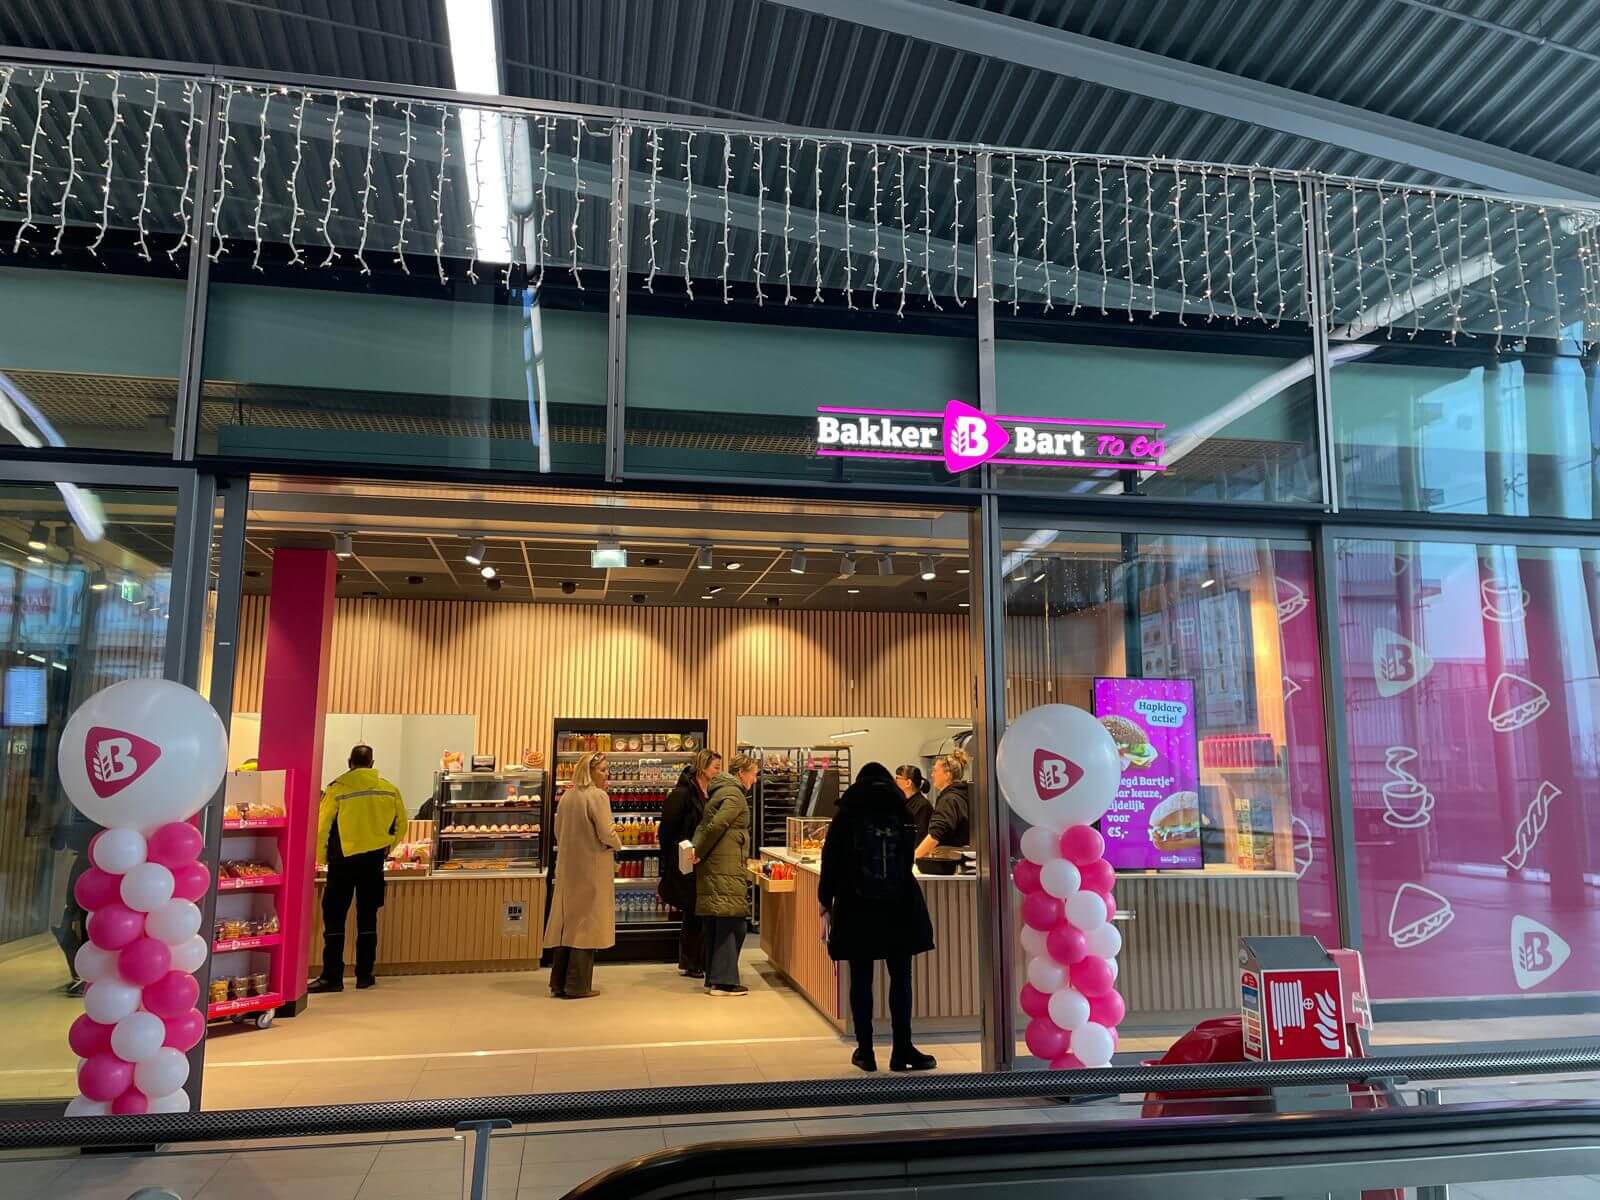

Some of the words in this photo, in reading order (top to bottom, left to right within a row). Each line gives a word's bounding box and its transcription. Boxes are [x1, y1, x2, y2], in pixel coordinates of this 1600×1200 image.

[817, 416, 938, 448] Bakker
[950, 416, 989, 457] B
[1014, 427, 1085, 456] Bart
[1138, 701, 1183, 713] Hapklare
[1151, 714, 1177, 724] actie!
[92, 737, 138, 782] B
[1039, 759, 1070, 790] B
[1131, 788, 1163, 800] keuze,
[1108, 800, 1145, 812] ijdelijk
[1106, 814, 1131, 823] voor
[1519, 931, 1553, 972] B
